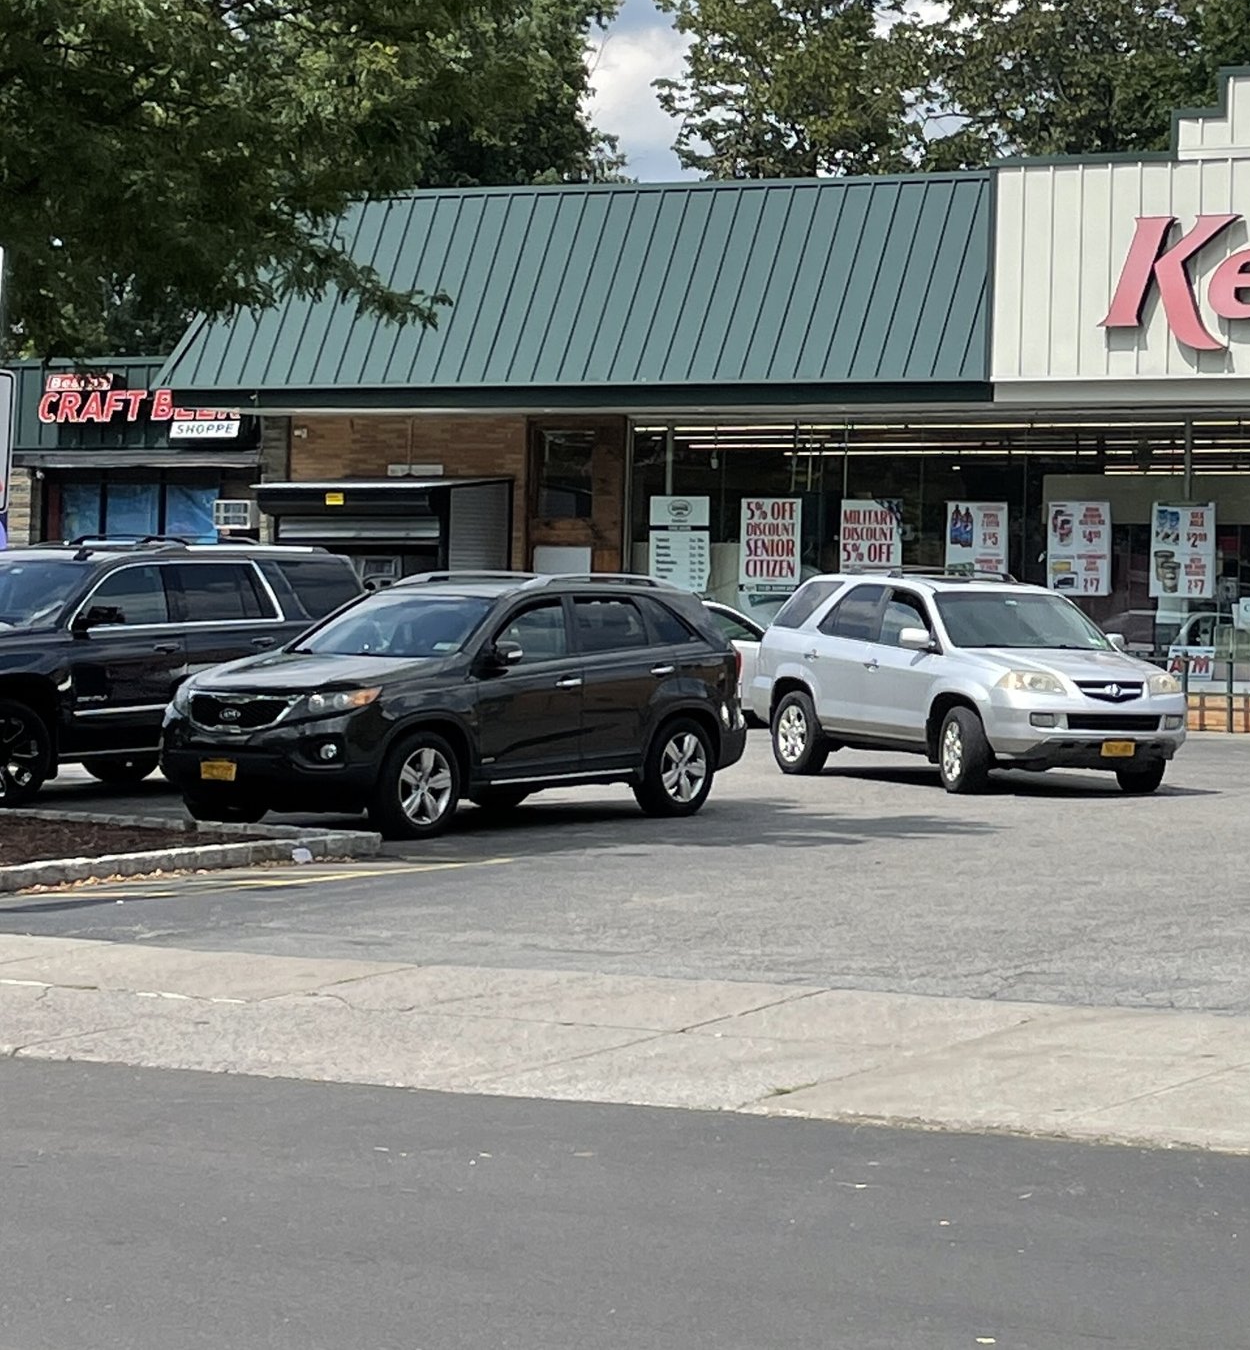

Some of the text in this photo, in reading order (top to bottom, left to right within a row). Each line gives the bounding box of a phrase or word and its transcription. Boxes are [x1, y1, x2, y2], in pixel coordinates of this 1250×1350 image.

[38, 390, 148, 423] CRAFT
[176, 423, 235, 435] SHOPPE
[746, 501, 796, 520] 5% OFF
[843, 509, 894, 525] MILITARY
[746, 522, 795, 537] DISCOUNT
[843, 527, 894, 541] DISCOUNT
[745, 538, 795, 557] SENIOR
[842, 543, 895, 563] 5% OFF
[745, 559, 795, 578] CITIZEN
[1170, 655, 1210, 674] AM
